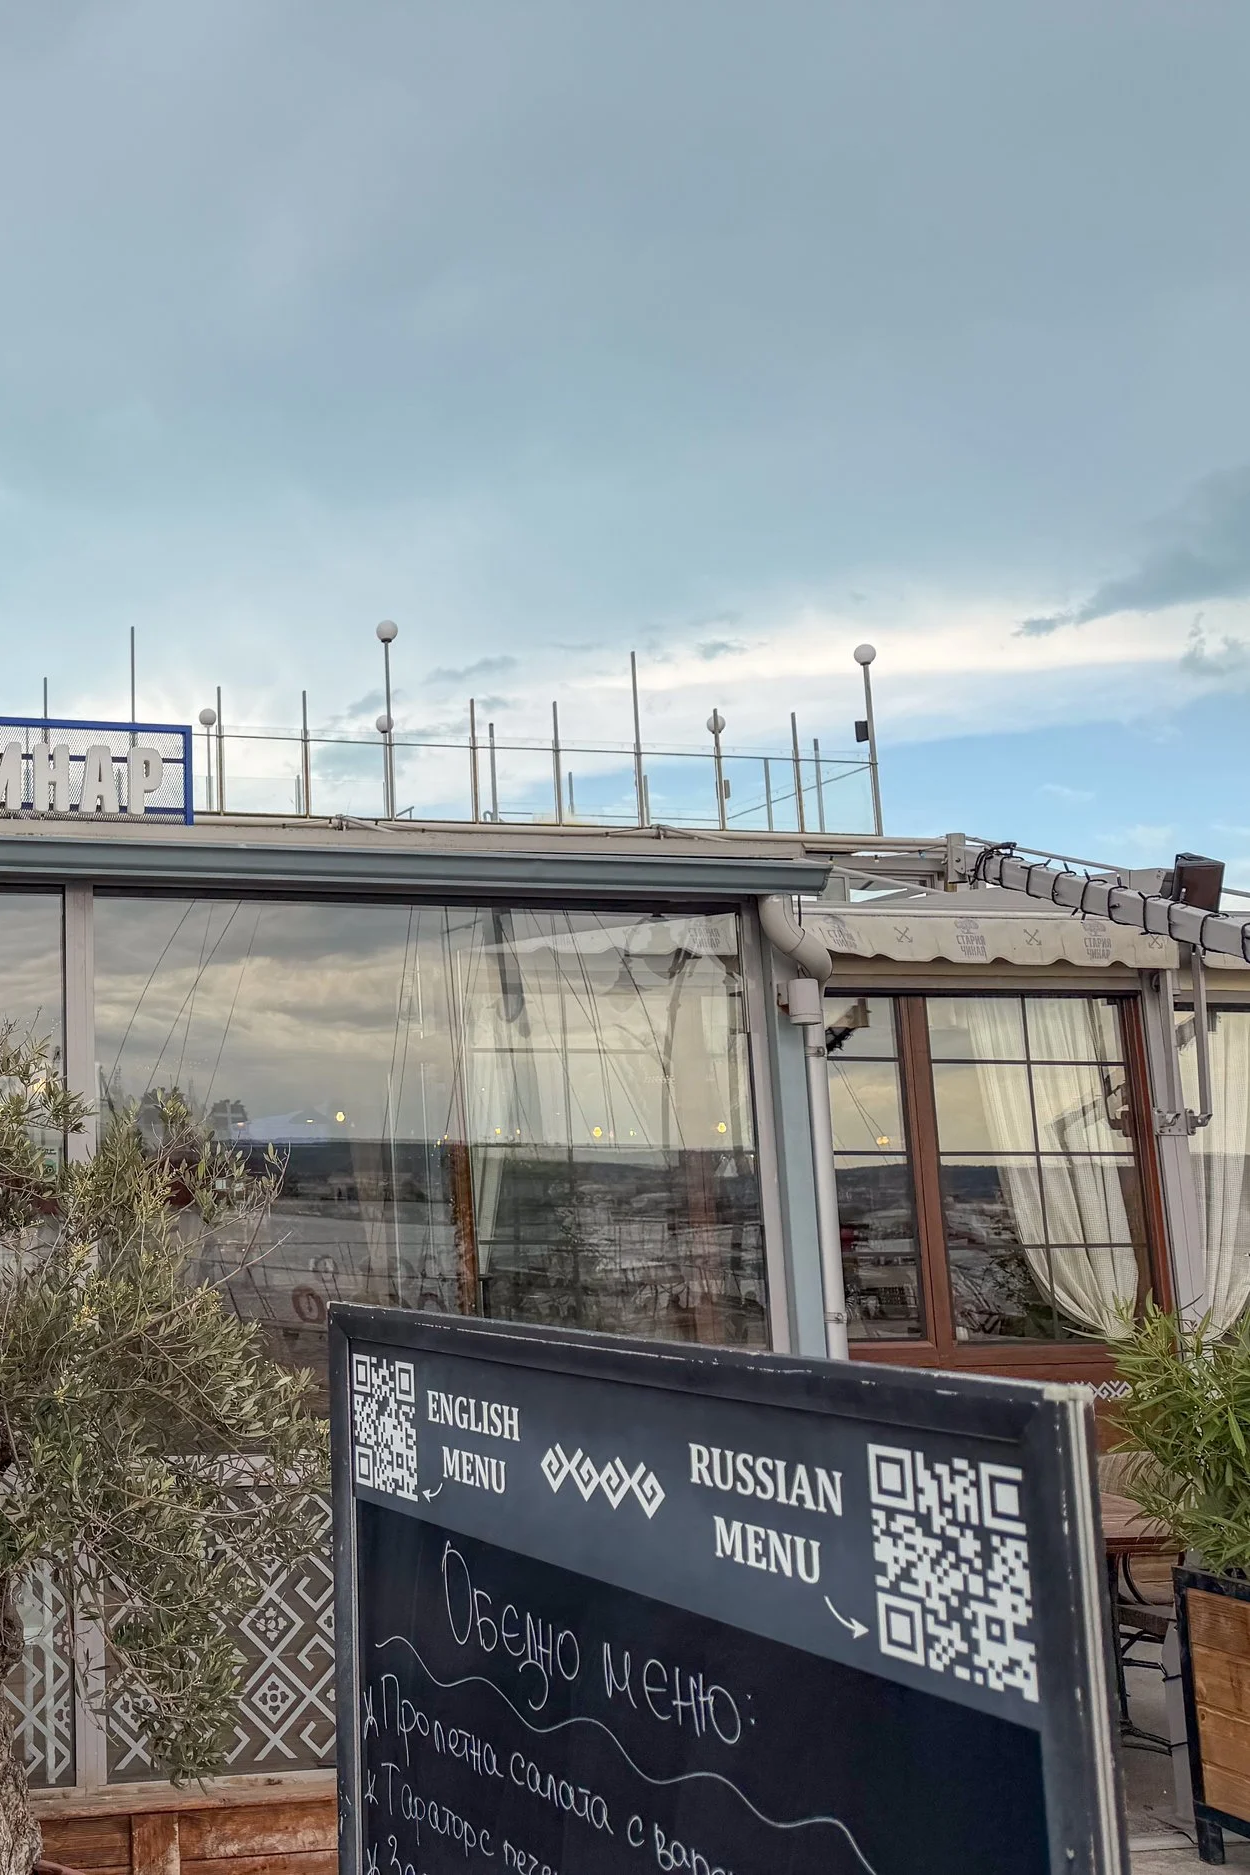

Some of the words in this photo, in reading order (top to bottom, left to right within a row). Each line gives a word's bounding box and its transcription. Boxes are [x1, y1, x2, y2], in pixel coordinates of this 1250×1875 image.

[956, 934, 986, 946] СТАРИЯ
[1084, 937, 1112, 949] СТАРИЯ
[427, 1389, 521, 1442] ENGLISH
[442, 1445, 506, 1494] MENU
[688, 1442, 843, 1517] RUSSIAN
[713, 1515, 821, 1584] MENU
[626, 1815, 645, 1847] с
